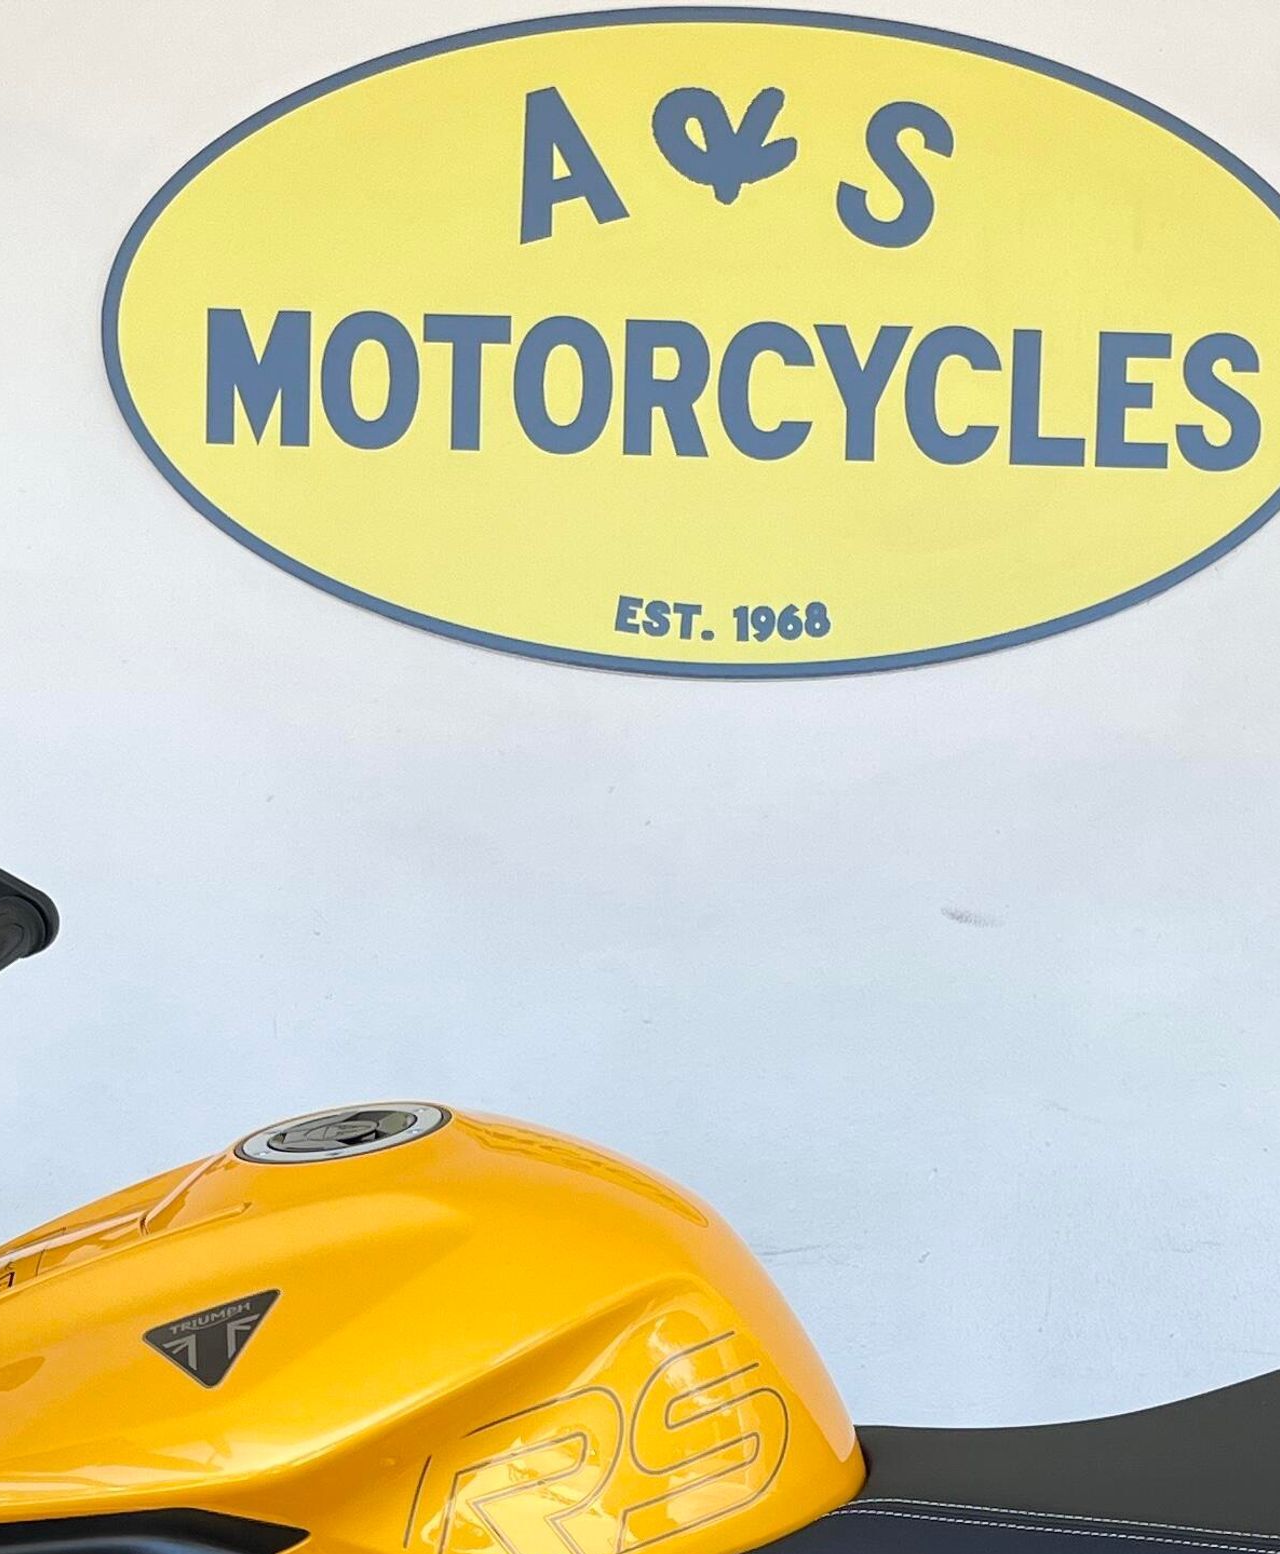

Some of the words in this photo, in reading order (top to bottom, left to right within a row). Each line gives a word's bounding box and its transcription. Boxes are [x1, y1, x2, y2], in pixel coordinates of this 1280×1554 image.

[520, 87, 629, 244] A
[836, 101, 954, 248] S
[205, 308, 1262, 472] MOTORCYCLES
[614, 596, 714, 642] EST.
[733, 601, 832, 642] 1968
[169, 1302, 251, 1334] TRIUMPH
